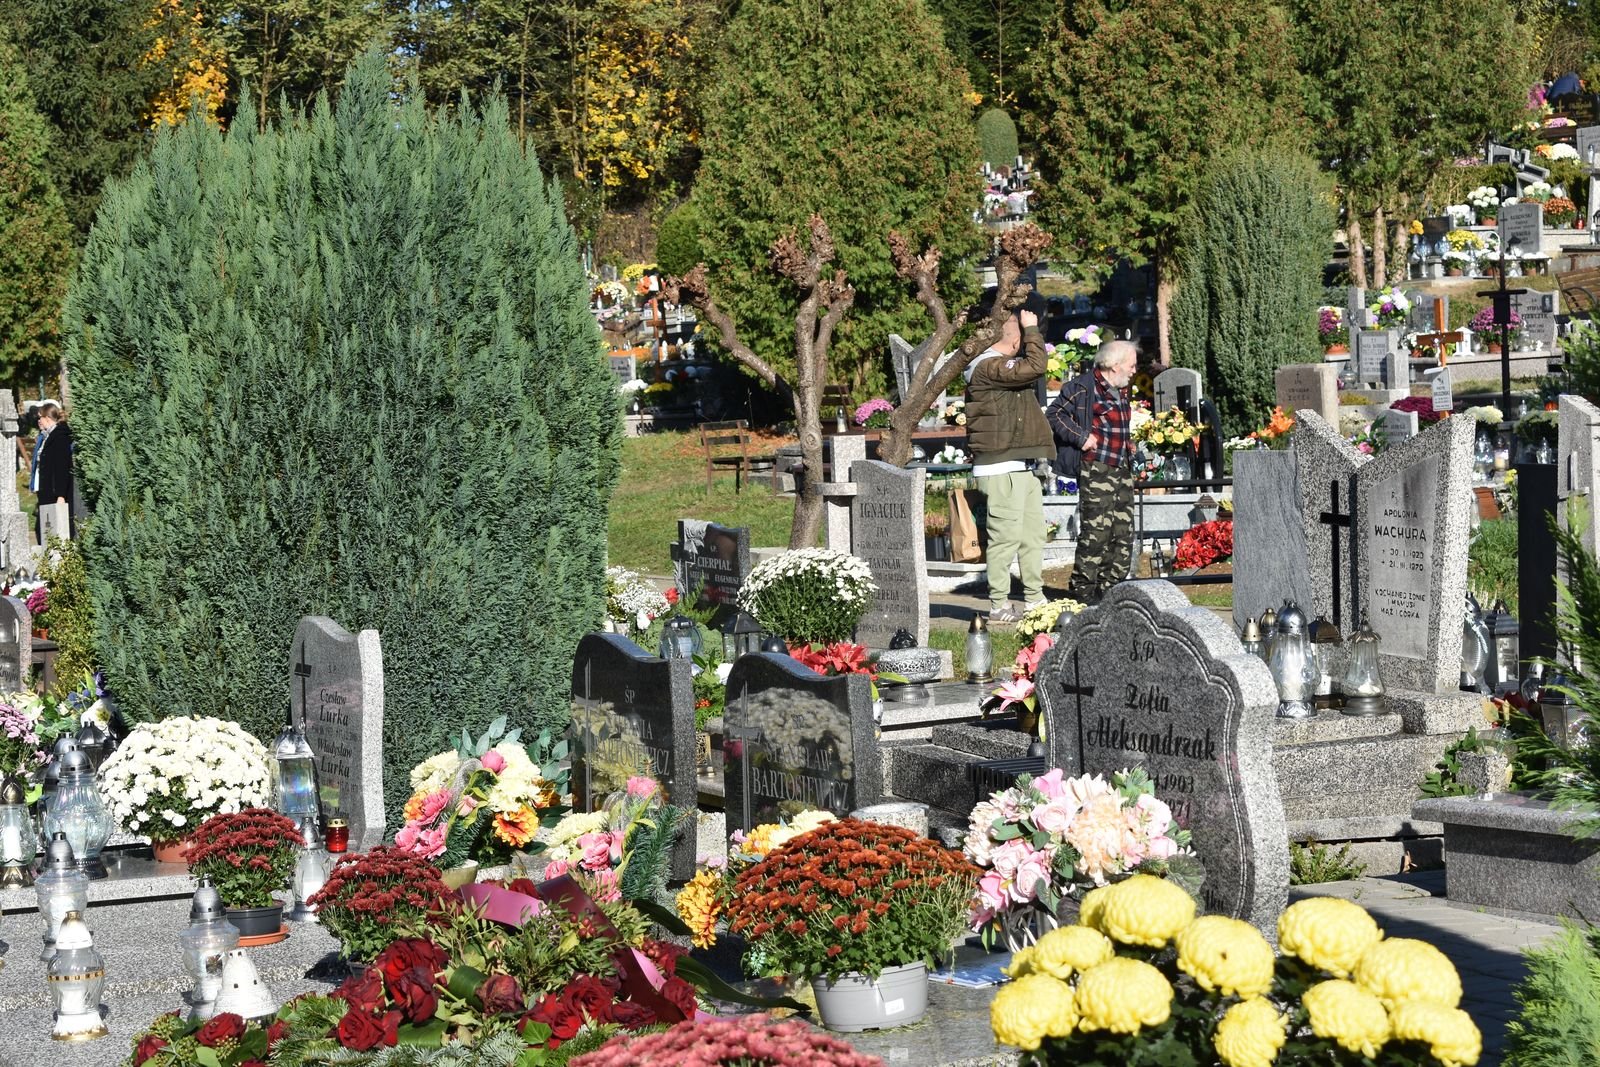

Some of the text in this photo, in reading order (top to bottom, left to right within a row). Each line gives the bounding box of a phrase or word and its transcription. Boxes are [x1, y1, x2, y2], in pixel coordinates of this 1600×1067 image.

[860, 503, 906, 519] IGNACIUK
[1384, 508, 1418, 519] APOLONIA
[1374, 524, 1427, 542] WACHURA
[1125, 683, 1169, 714] Zofia
[320, 704, 349, 726] Lurka
[1086, 715, 1217, 761] Aleksandrzak
[320, 756, 350, 778] Lurka
[752, 766, 850, 812] BARTOSIEWICZ
